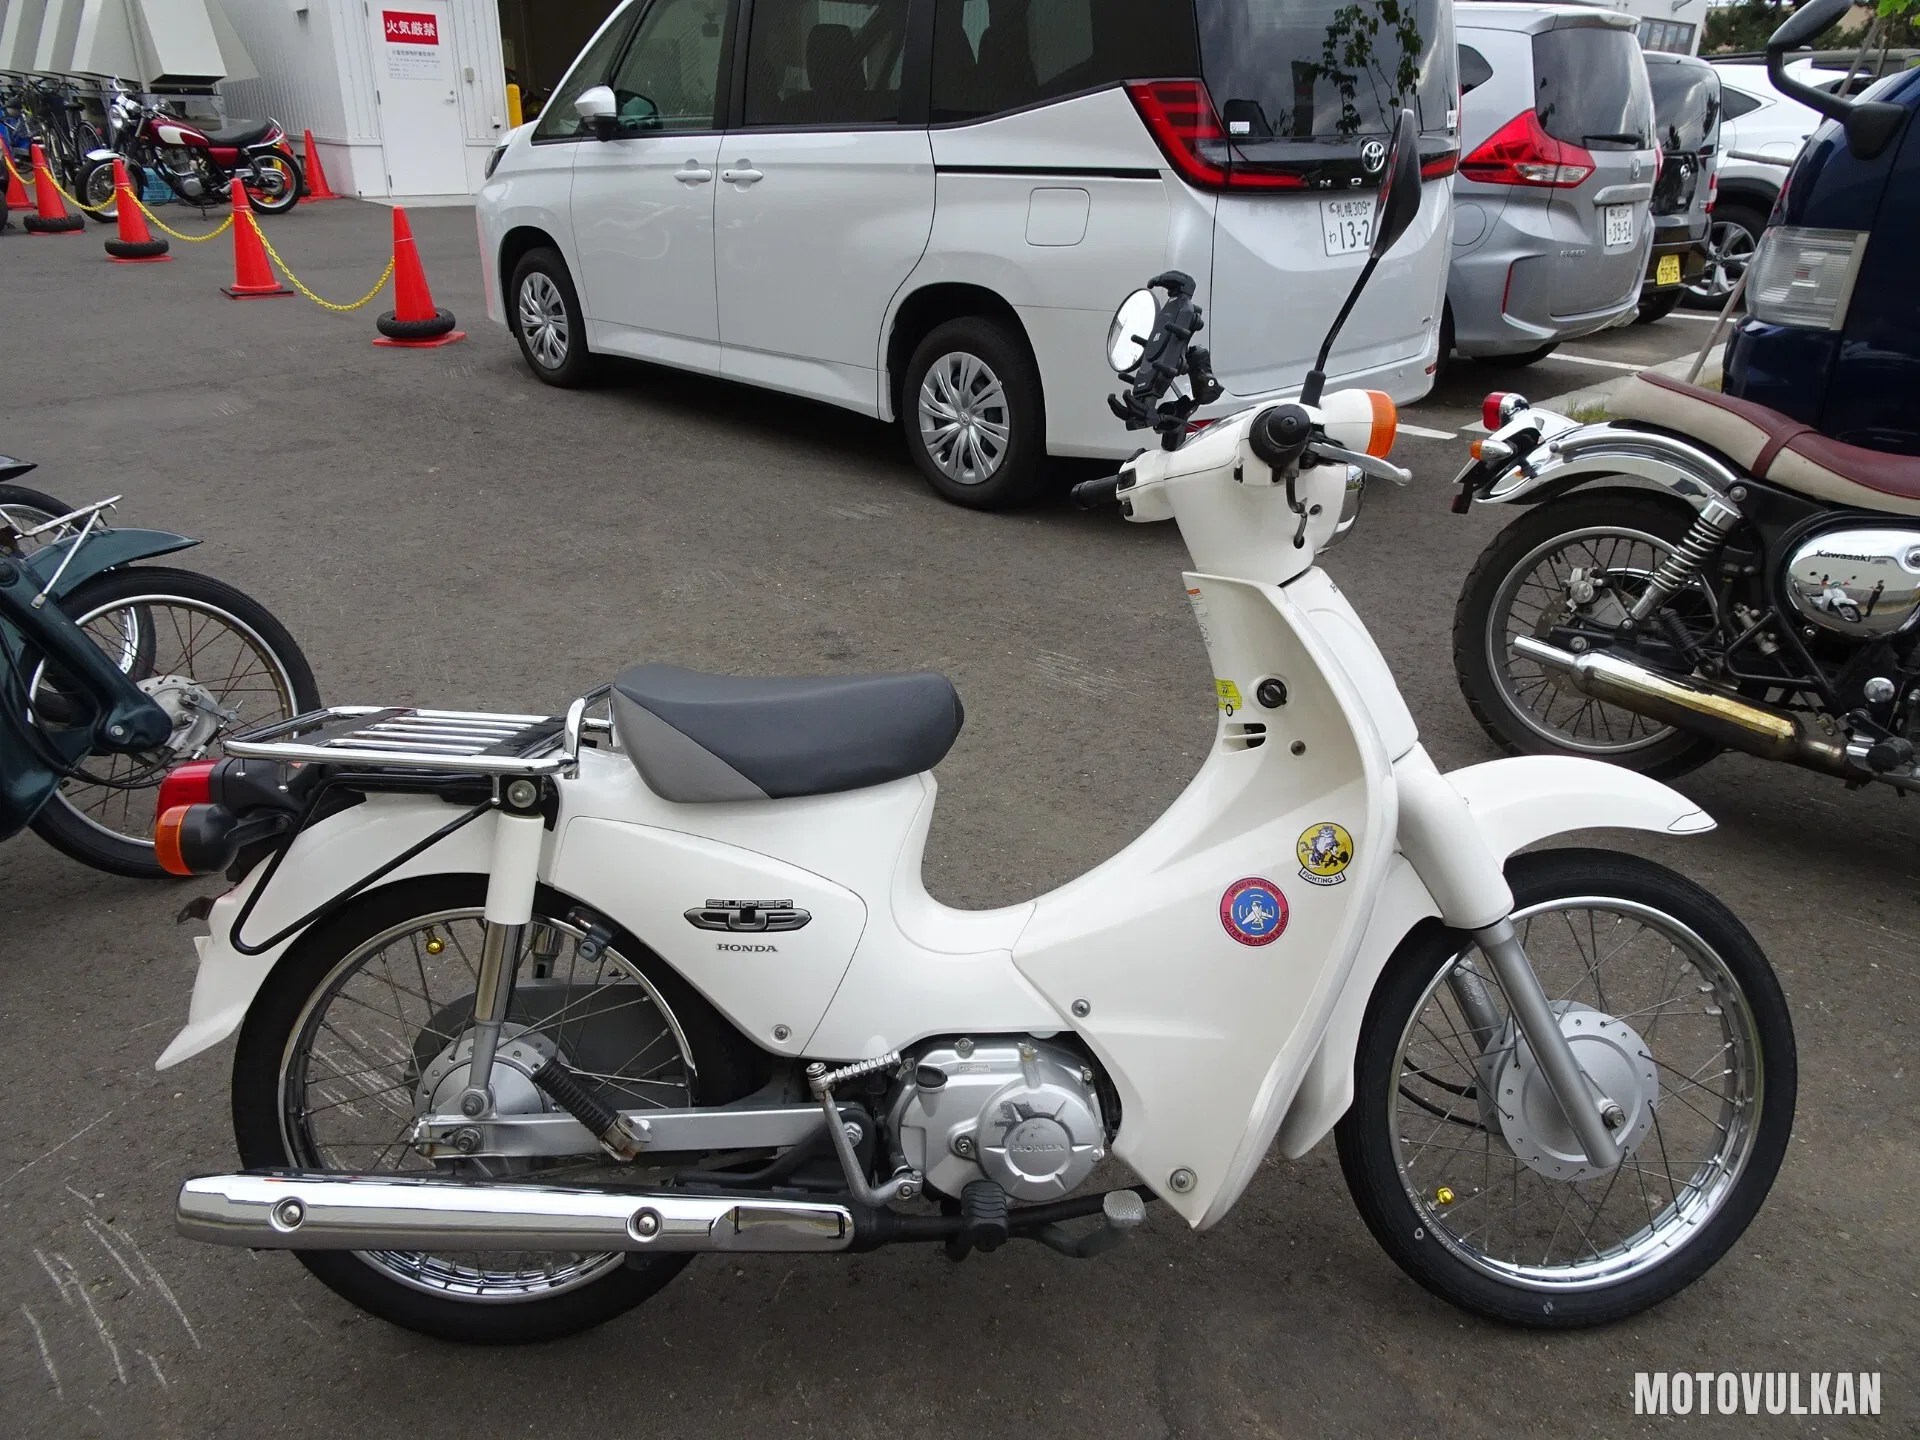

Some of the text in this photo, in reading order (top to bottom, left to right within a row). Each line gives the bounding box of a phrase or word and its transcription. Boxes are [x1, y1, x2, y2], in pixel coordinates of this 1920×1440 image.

[386, 19, 436, 37] 火気厳禁
[1339, 219, 1370, 249] 13-2
[1815, 549, 1872, 563] Kawasaki
[1301, 870, 1333, 884] FIGHTING
[705, 899, 793, 909] SUPER
[1222, 911, 1243, 940] FIGHTER
[1242, 932, 1276, 945] WEAPONS
[715, 943, 778, 953] HONDA
[1012, 1144, 1065, 1153] HONDA
